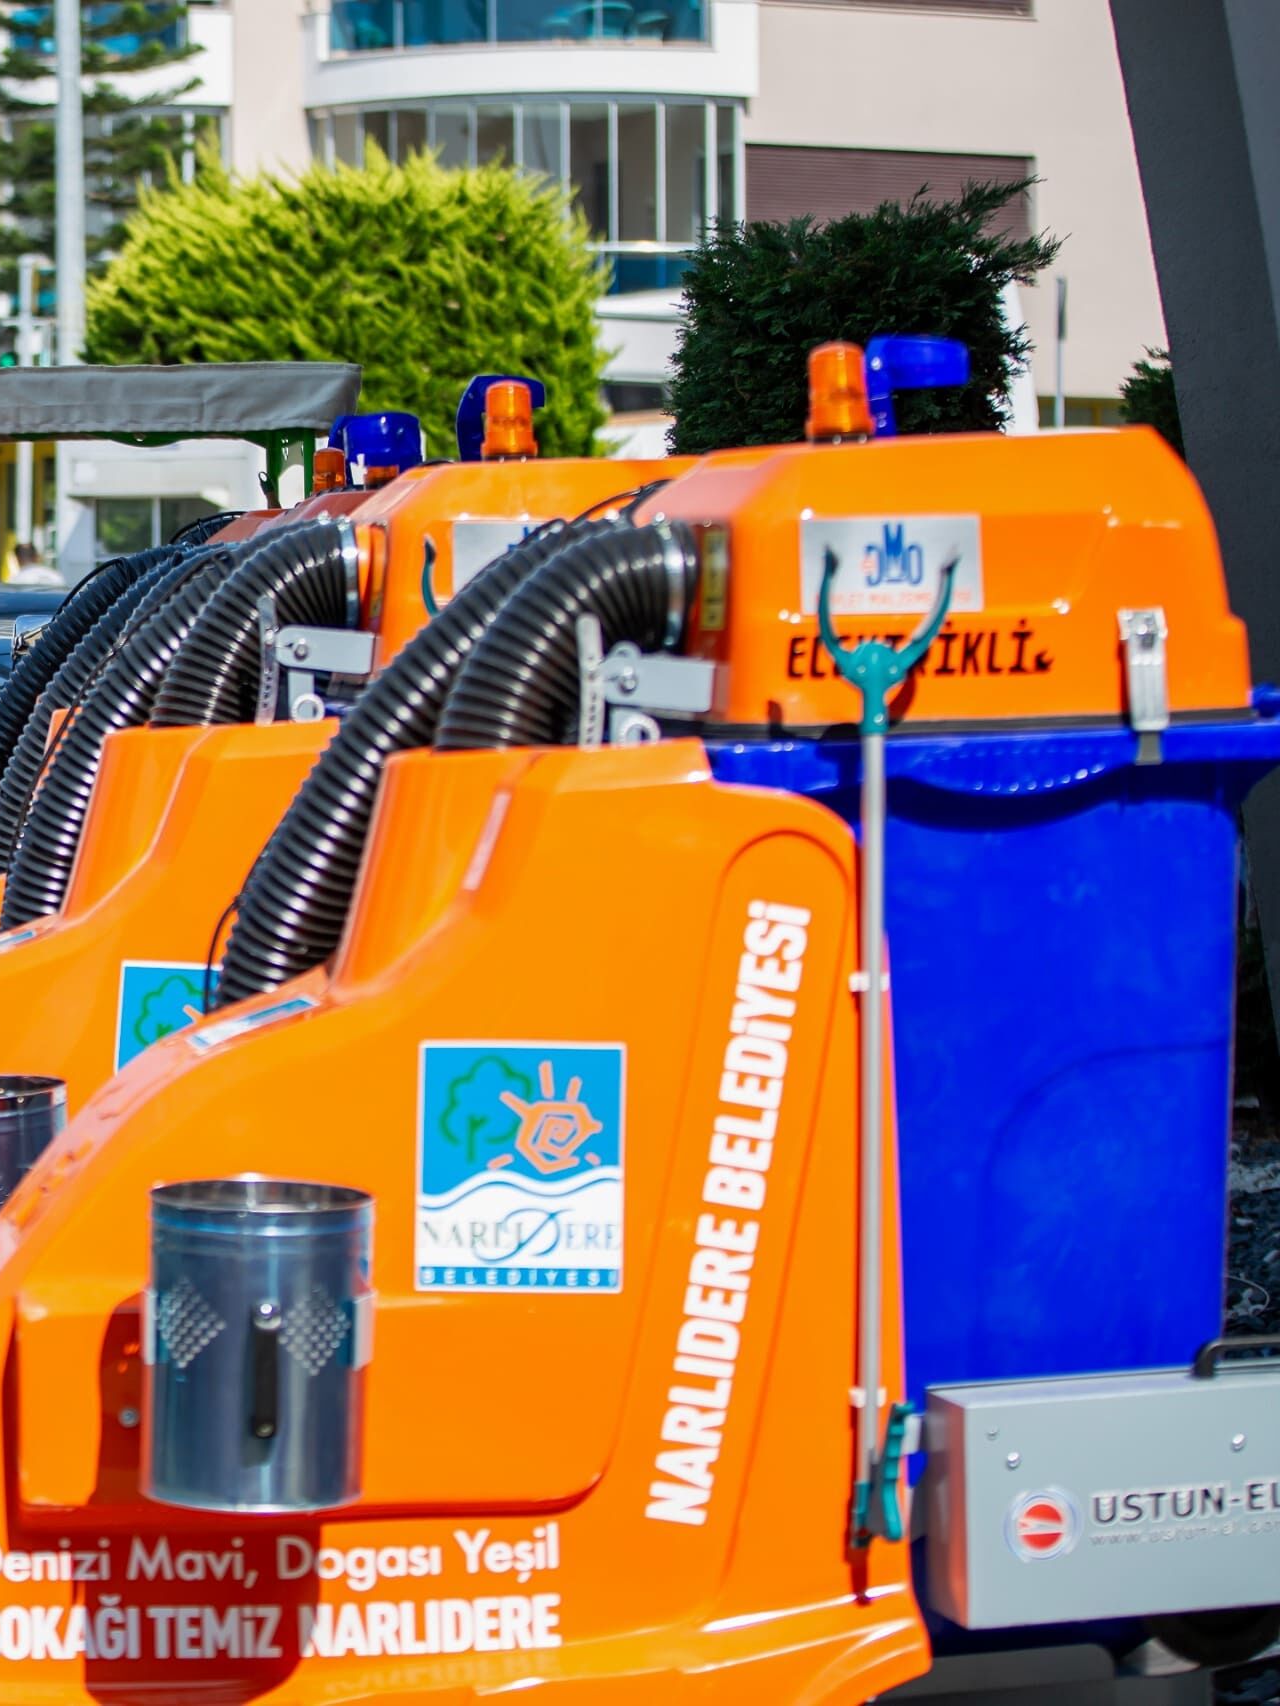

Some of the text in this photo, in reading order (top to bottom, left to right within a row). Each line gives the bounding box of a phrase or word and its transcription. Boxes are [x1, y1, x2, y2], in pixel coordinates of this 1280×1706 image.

[644, 1213, 760, 1526] NARLIDERE
[126, 1536, 259, 1589] Mavi,
[453, 1521, 560, 1583] Yeşil
[298, 1593, 562, 1658] NARLIDERE
